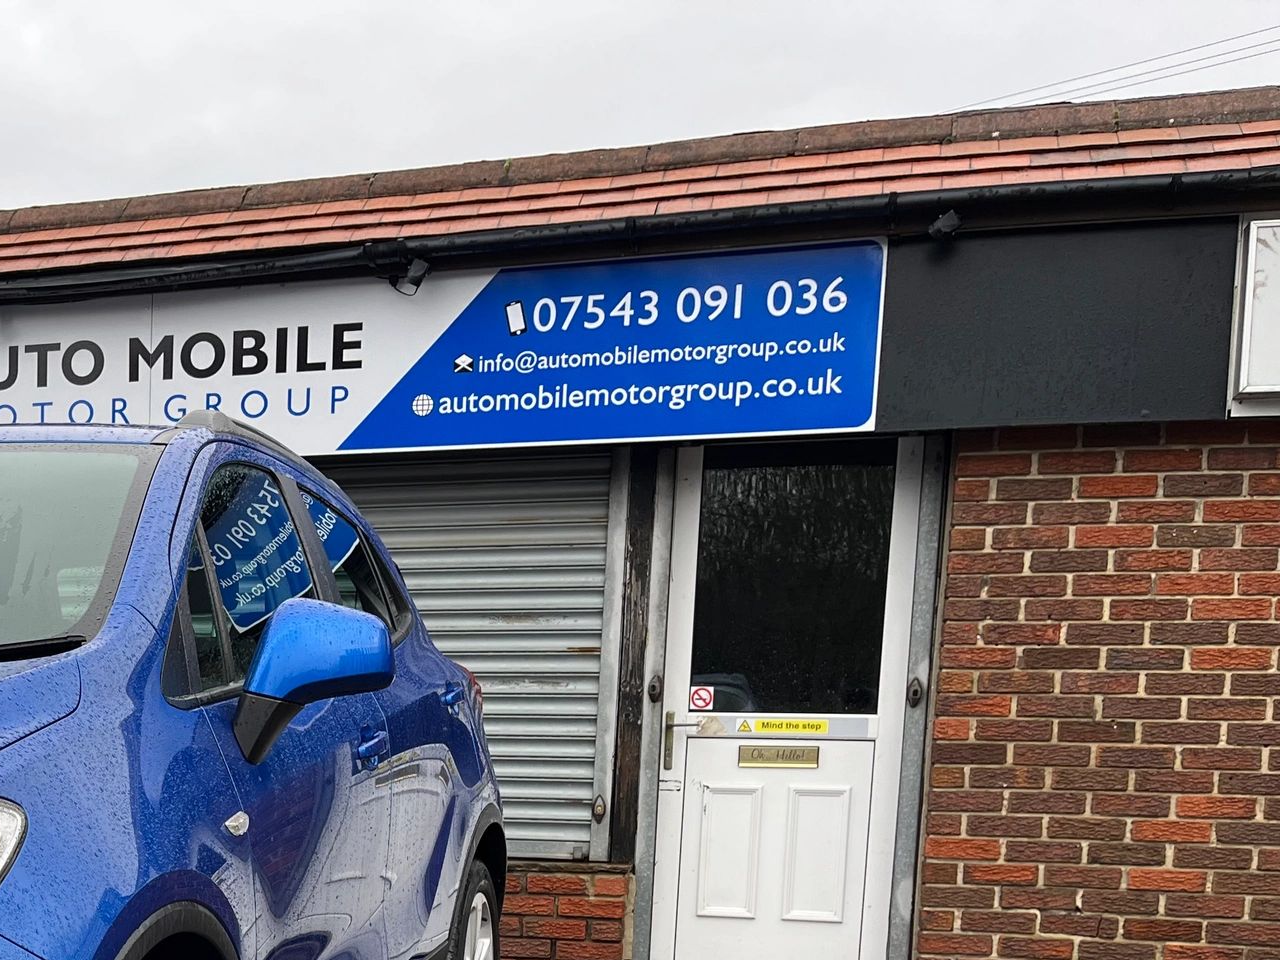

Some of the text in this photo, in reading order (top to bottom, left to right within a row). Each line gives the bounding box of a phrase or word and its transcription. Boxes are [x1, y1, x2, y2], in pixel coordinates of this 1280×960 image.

[532, 276, 848, 333] 07543 091 036
[127, 322, 363, 383] MOBILE
[477, 331, 846, 375] info@automobilemotorgroup.co.uk
[163, 386, 349, 422] GROUP
[438, 369, 842, 416] automobilemotorgroup.co.uk
[761, 721, 822, 732] Mind the step
